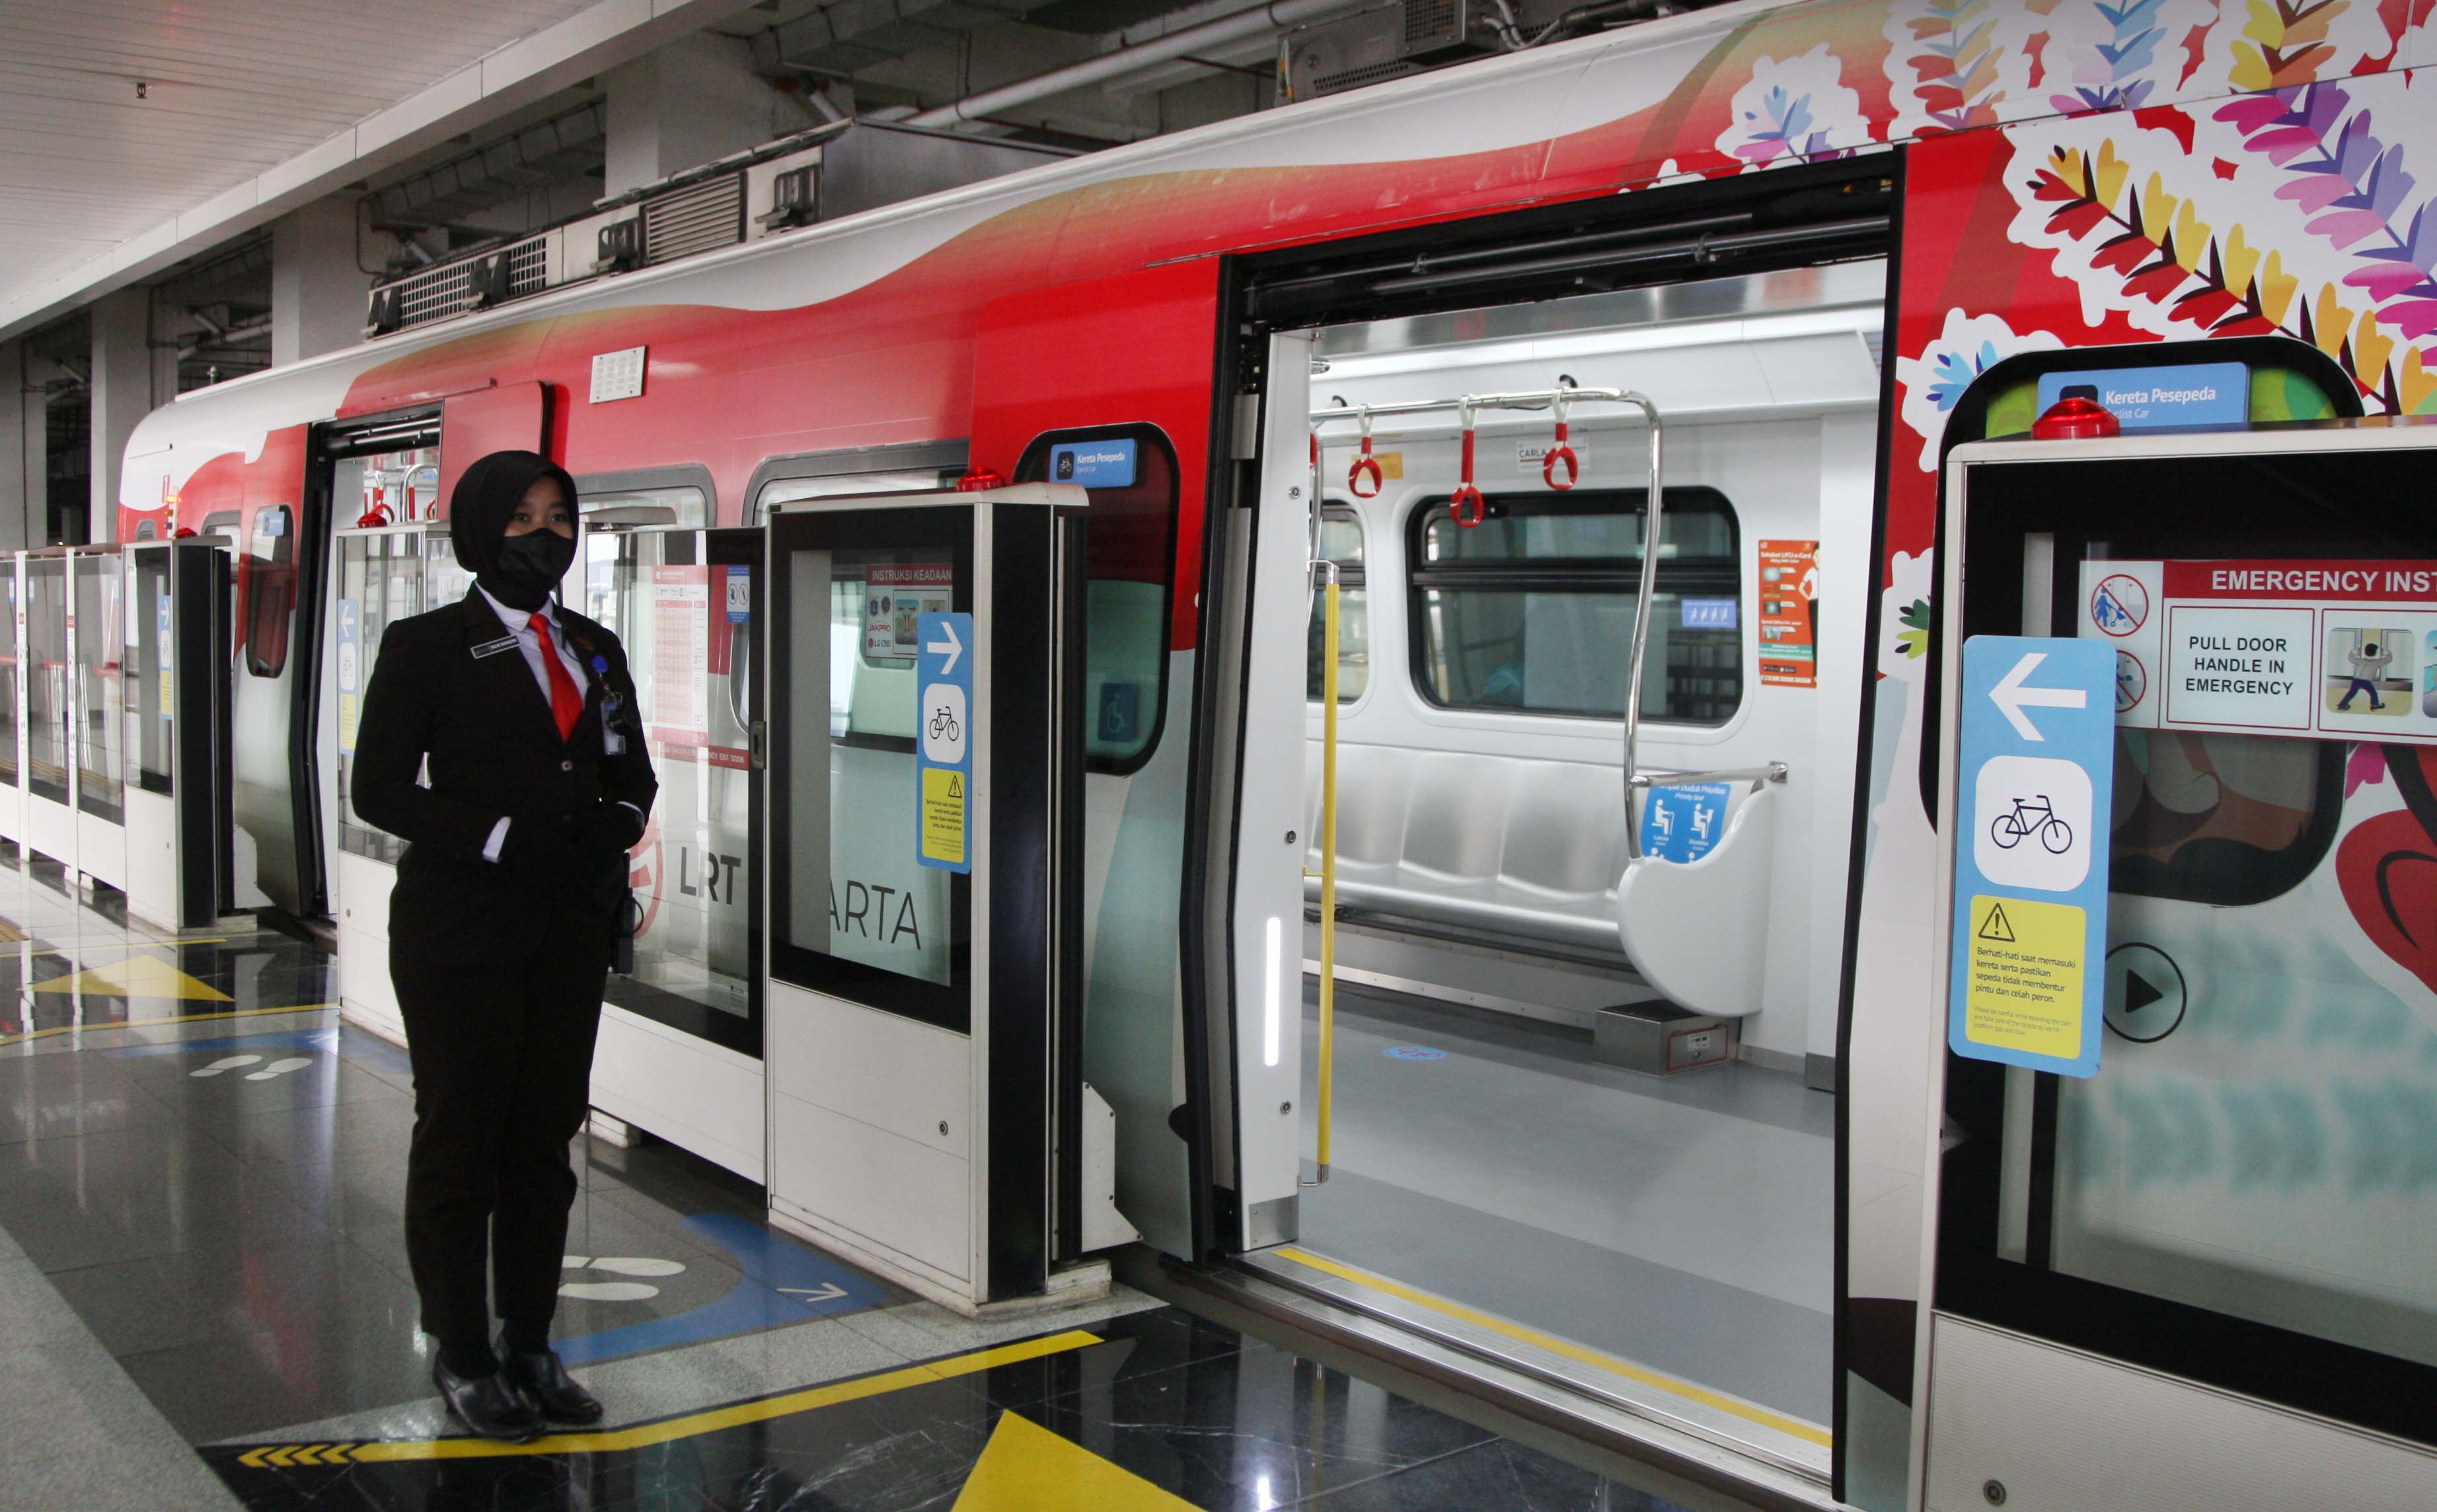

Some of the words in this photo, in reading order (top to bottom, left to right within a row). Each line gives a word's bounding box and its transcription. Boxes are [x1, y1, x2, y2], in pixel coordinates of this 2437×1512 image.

[2106, 391, 2148, 405] Kereta
[2152, 386, 2216, 405] Pesepeda
[2135, 408, 2151, 418] Car
[872, 570, 913, 582] INSTRUKSI
[2212, 570, 2379, 592] EMERGENCY
[2189, 636, 2231, 650] PULL
[2237, 638, 2287, 652] DOOR
[2194, 657, 2262, 673] HANDLE
[2268, 660, 2284, 673] IN
[2186, 678, 2294, 696] EMERGENCY
[681, 847, 741, 905] LRT
[1977, 946, 2019, 960] Berhati-hati
[2021, 954, 2037, 963] saat
[2038, 957, 2076, 968] memasuki
[1976, 960, 1998, 969] kereta
[2000, 964, 2019, 973] serta
[2020, 966, 2050, 977] pastikan
[1976, 973, 2001, 982] sepeda
[2003, 976, 2020, 985] tidak
[2022, 979, 2066, 992] membentur
[1976, 985, 1994, 993] pintu
[1996, 987, 2009, 996] dan
[2011, 990, 2029, 999] celah
[2031, 993, 2055, 1003] peron.
